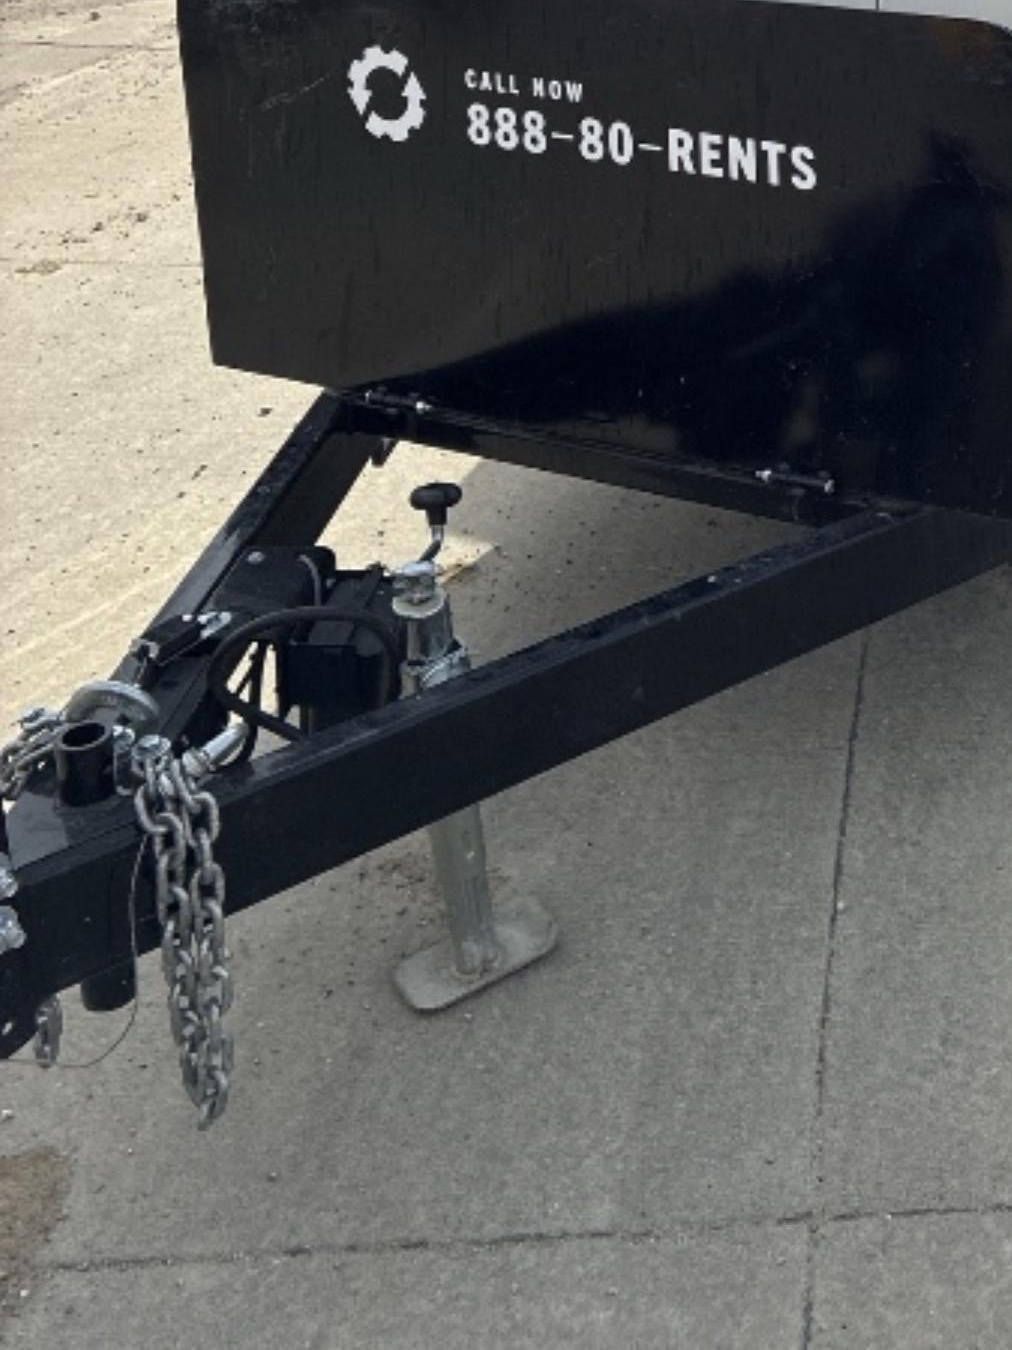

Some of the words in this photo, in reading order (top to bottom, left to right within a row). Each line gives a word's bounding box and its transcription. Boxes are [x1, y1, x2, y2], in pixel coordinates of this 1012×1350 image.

[464, 68, 520, 94] CALL
[532, 77, 583, 102] NOW
[466, 103, 818, 190] 888-80-RENTS
